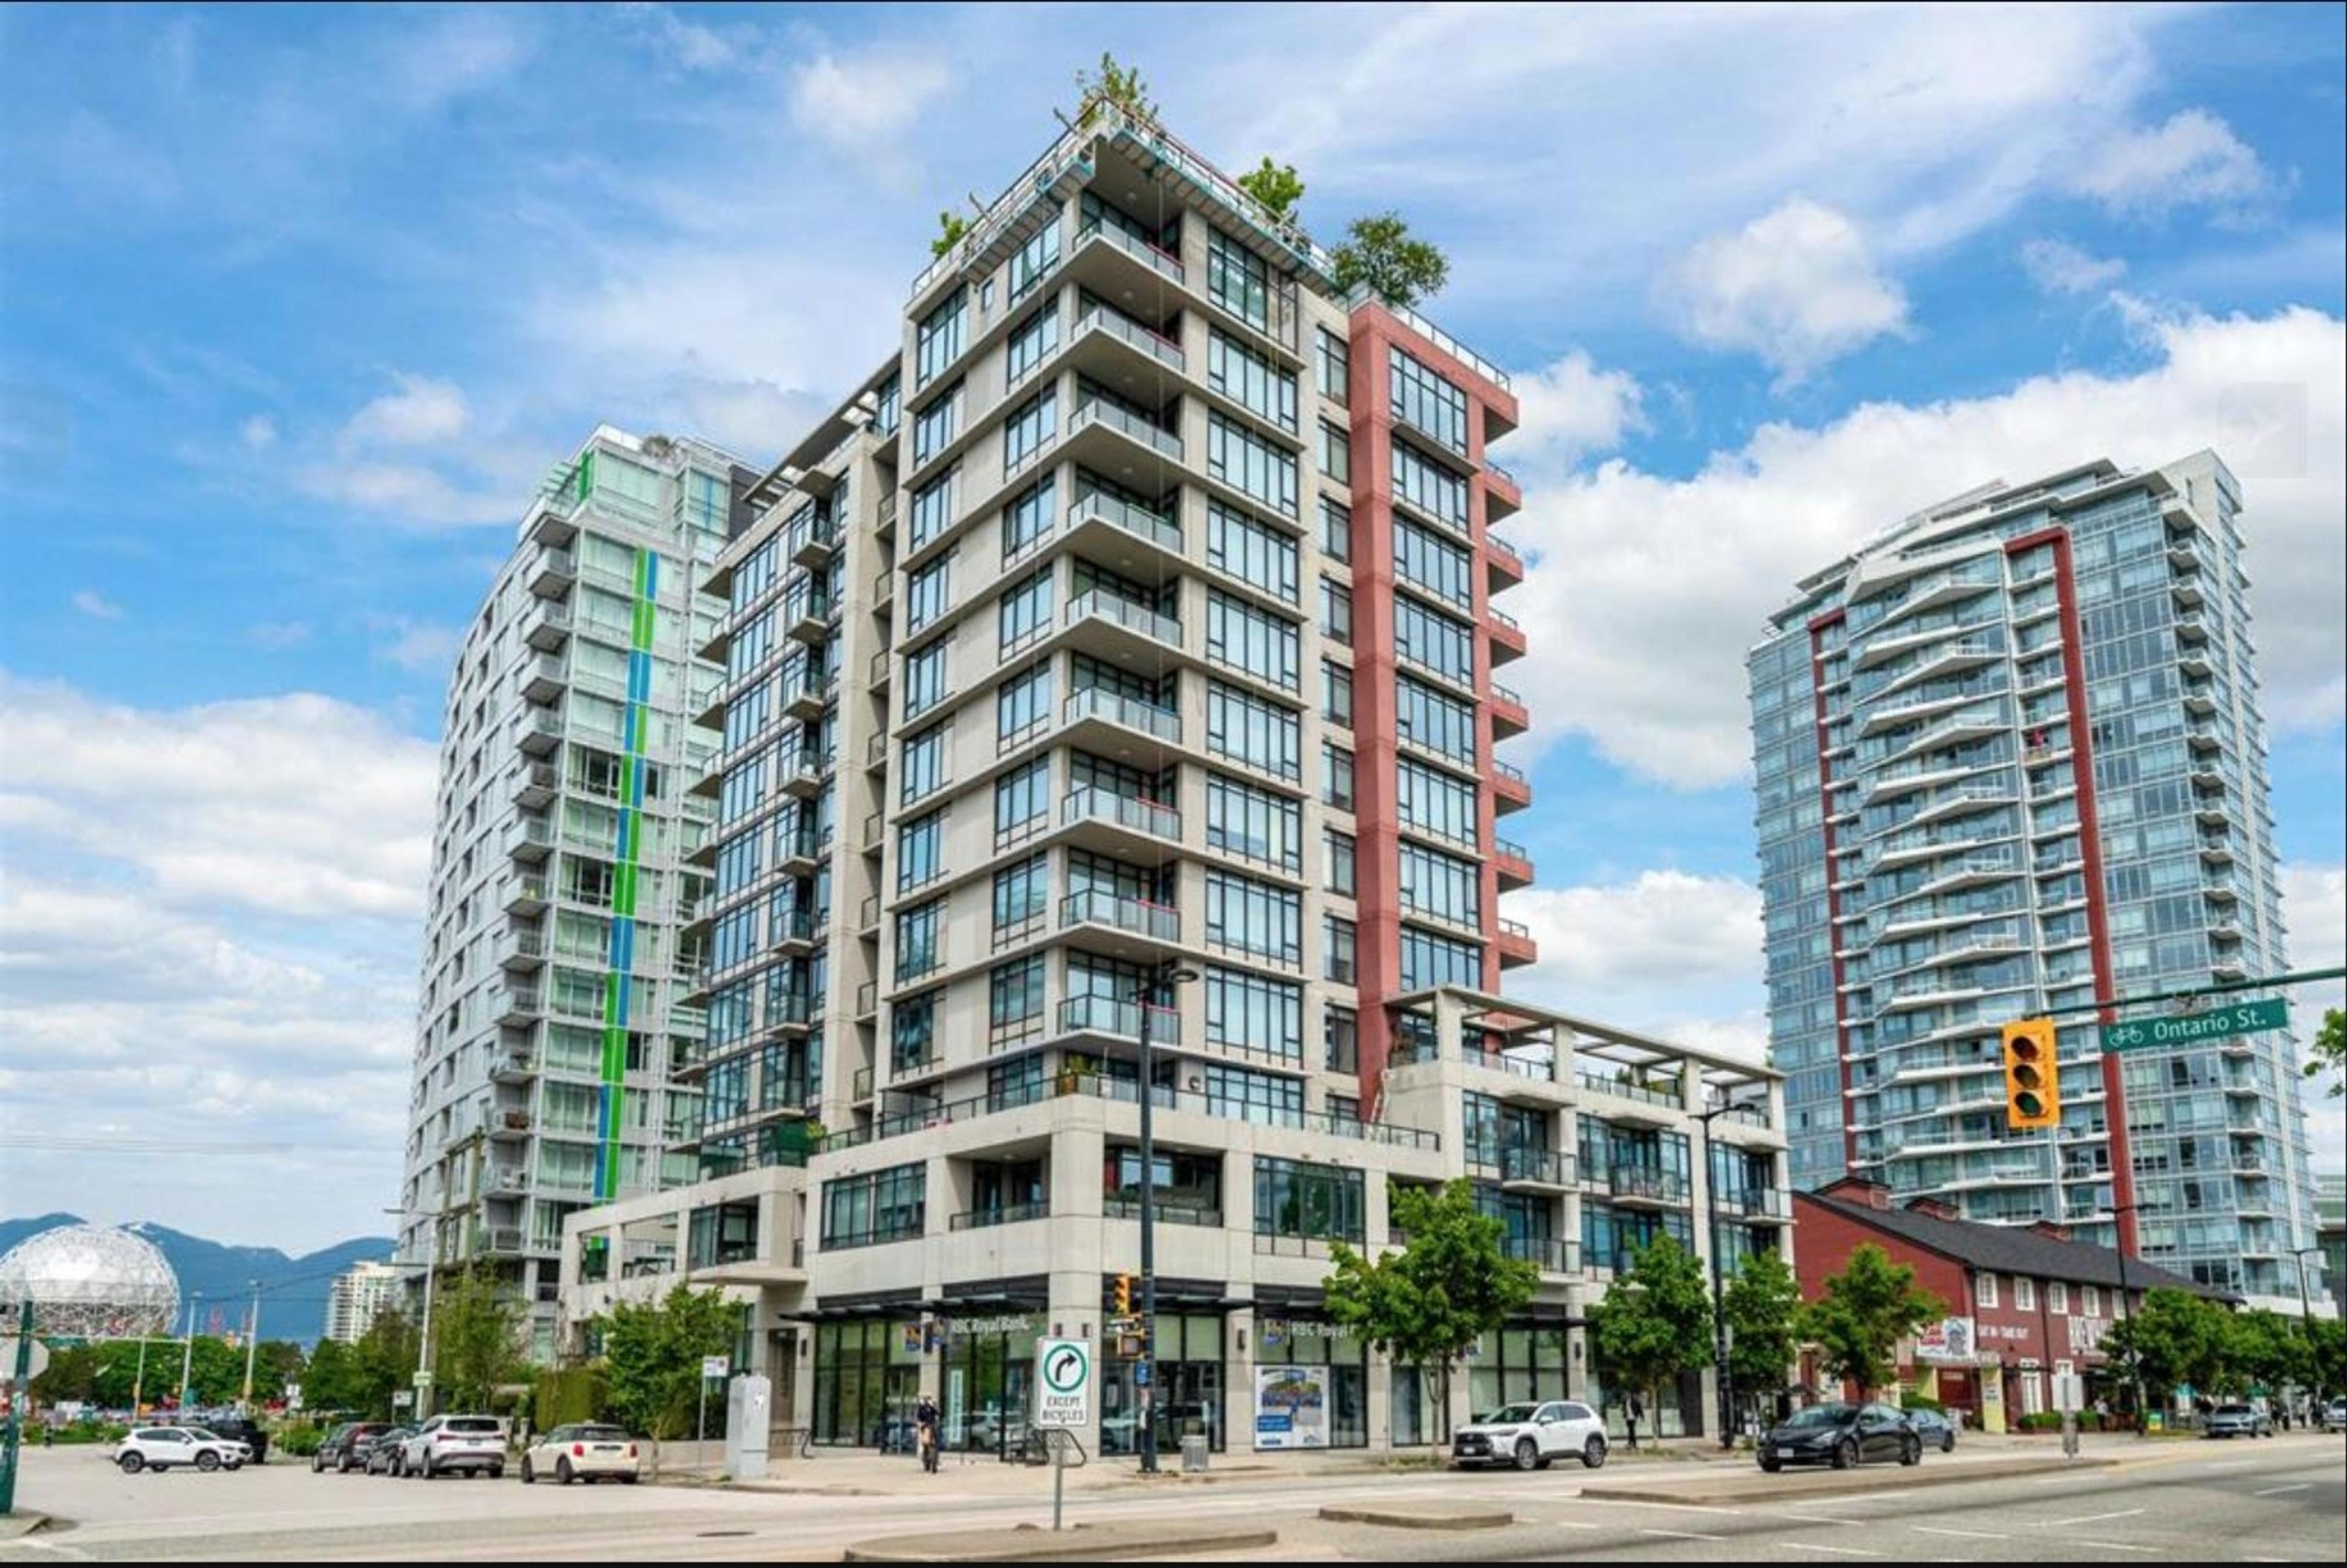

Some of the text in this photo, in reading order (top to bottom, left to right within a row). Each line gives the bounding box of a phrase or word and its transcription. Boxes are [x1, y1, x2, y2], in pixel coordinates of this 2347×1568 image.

[2154, 1009, 2266, 1039] Ontario St.
[972, 1316, 1000, 1336] Royal
[1046, 1396, 1080, 1407] EXCEPT
[1042, 1410, 1084, 1421] BICYCLES
